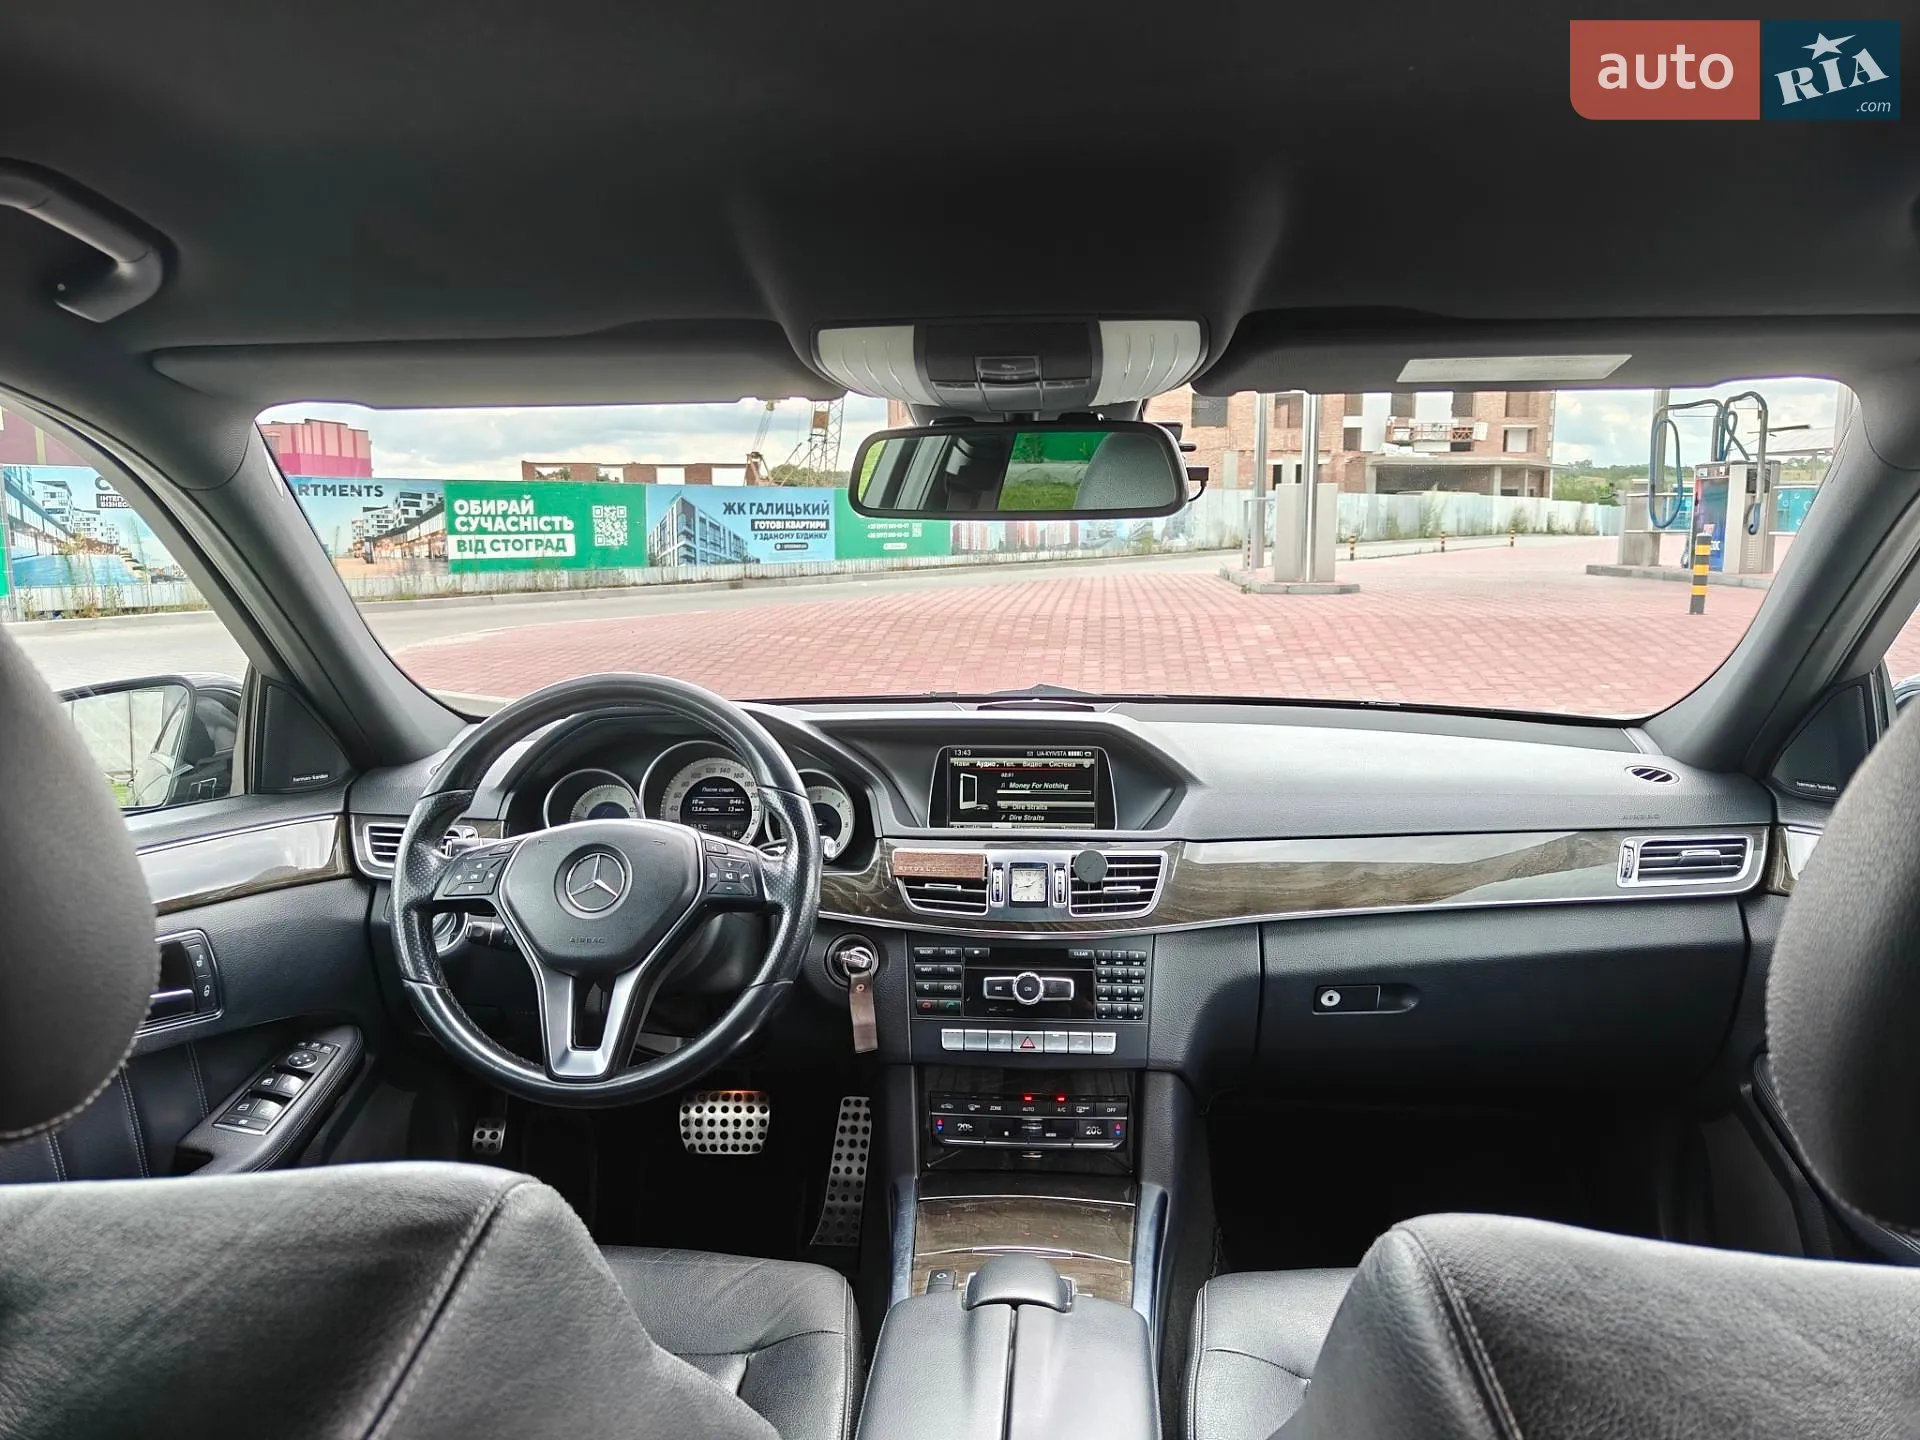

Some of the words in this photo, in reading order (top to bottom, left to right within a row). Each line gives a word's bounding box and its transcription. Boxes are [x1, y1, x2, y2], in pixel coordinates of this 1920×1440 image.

[453, 494, 535, 516] ОБИРАЙ
[722, 502, 746, 515] ЖК
[749, 500, 830, 517] ГАЛИЦЬКИЙ
[454, 515, 575, 533] СУЧАСНІСТЬ
[754, 520, 785, 530] ГОТОВІ
[785, 520, 827, 530] КВАРТИРИ
[796, 532, 828, 540] БУДИНКУ
[456, 539, 487, 555] ВІД
[489, 538, 568, 552] СТОГРАД
[1009, 782, 1030, 790] Money
[1043, 782, 1070, 790] Nothing
